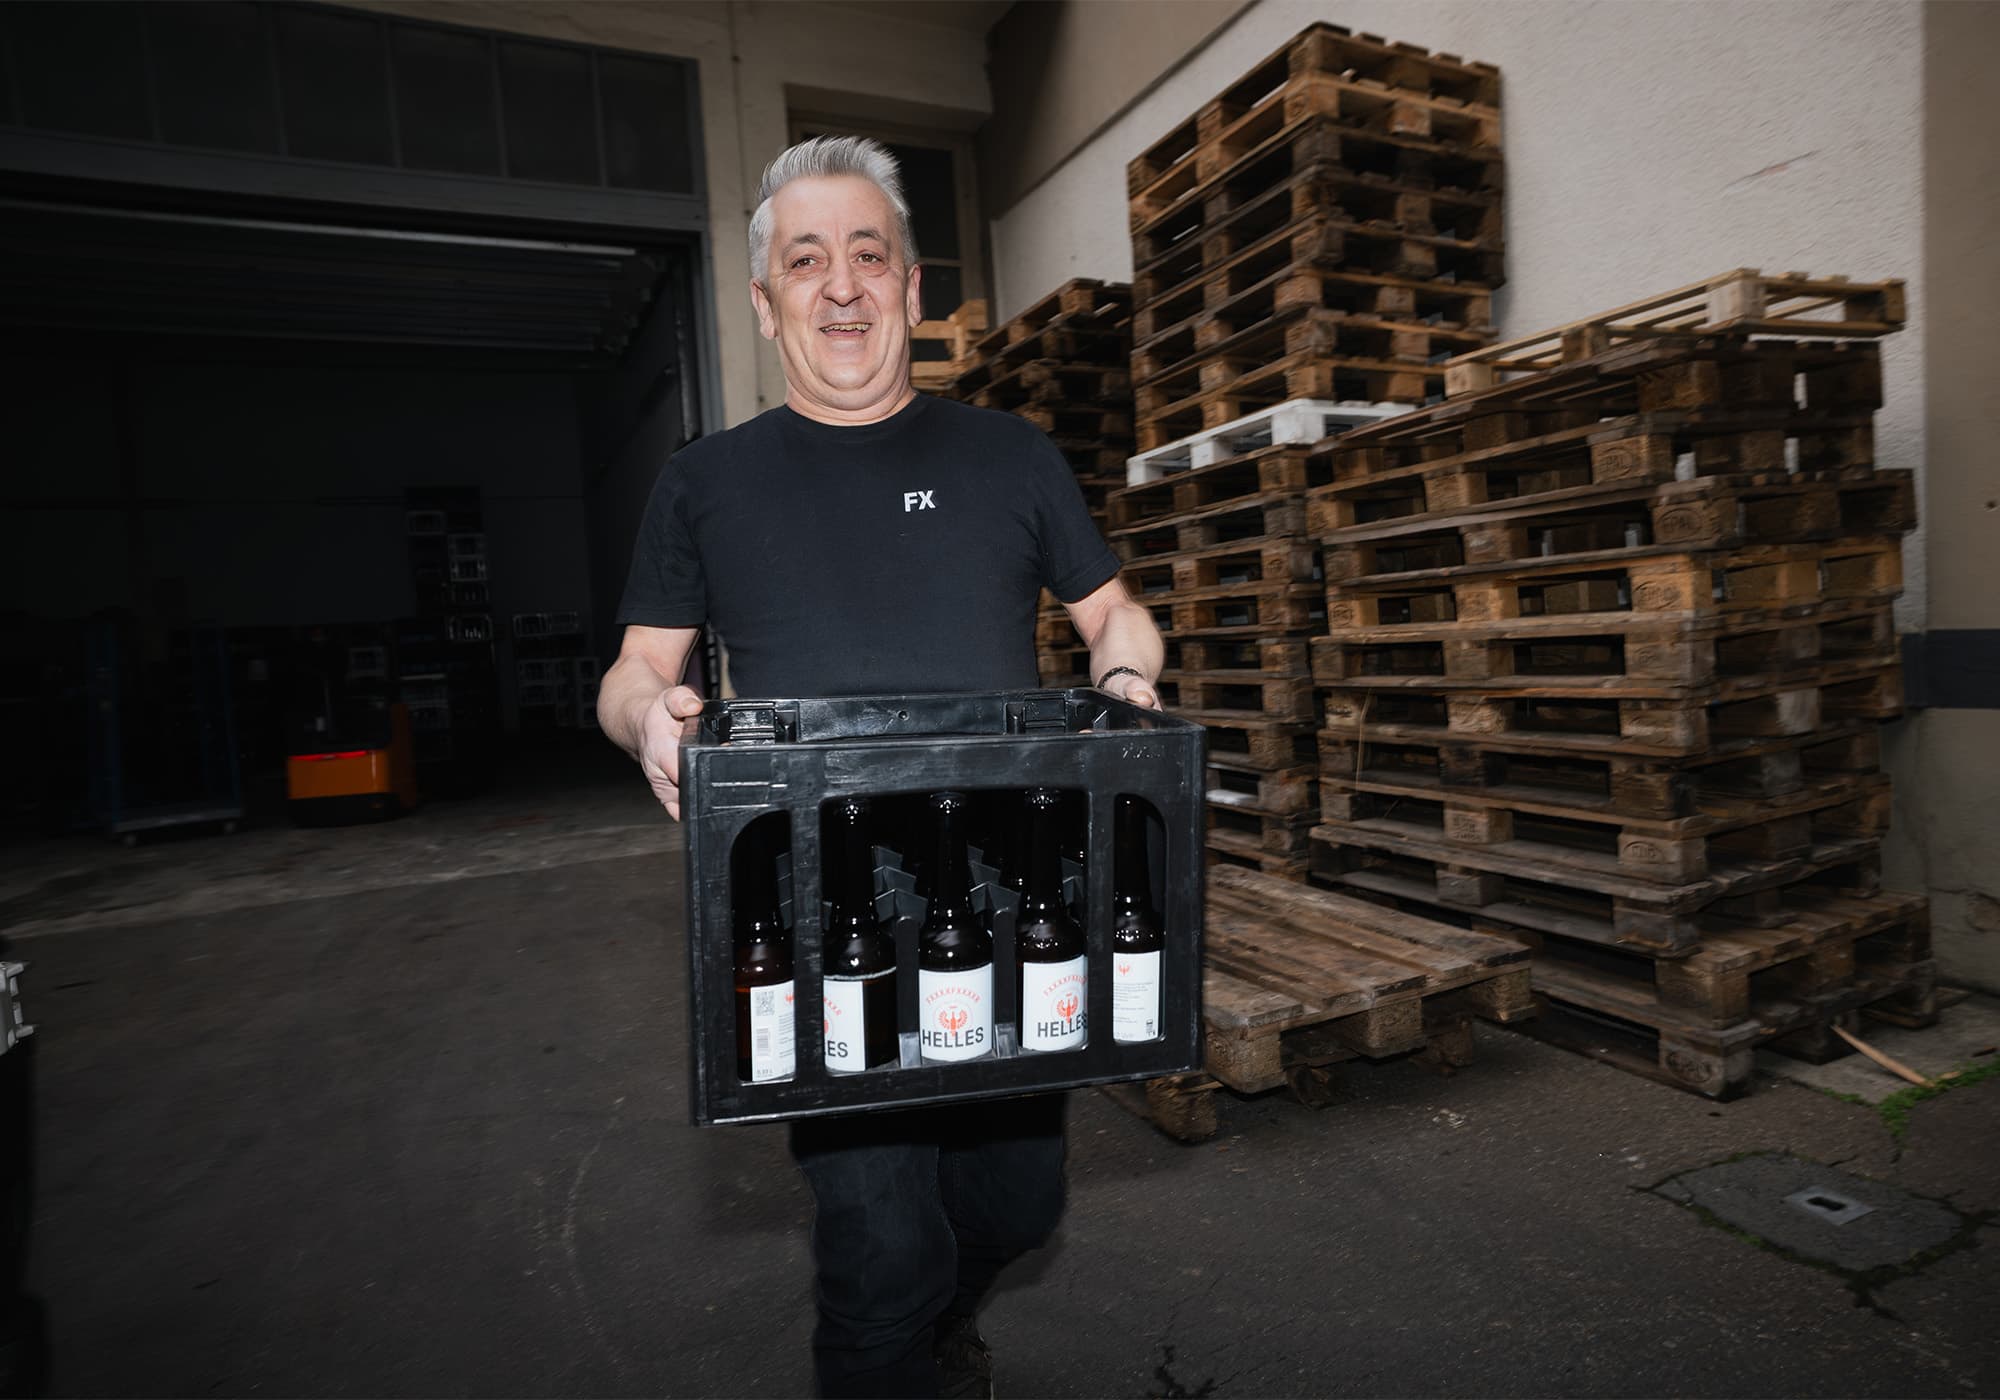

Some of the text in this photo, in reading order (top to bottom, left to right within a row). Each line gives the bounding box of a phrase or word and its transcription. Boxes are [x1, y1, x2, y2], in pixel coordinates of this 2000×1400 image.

[903, 490, 936, 512] FX
[922, 1026, 984, 1048] HELLES
[824, 1040, 849, 1058] ES
